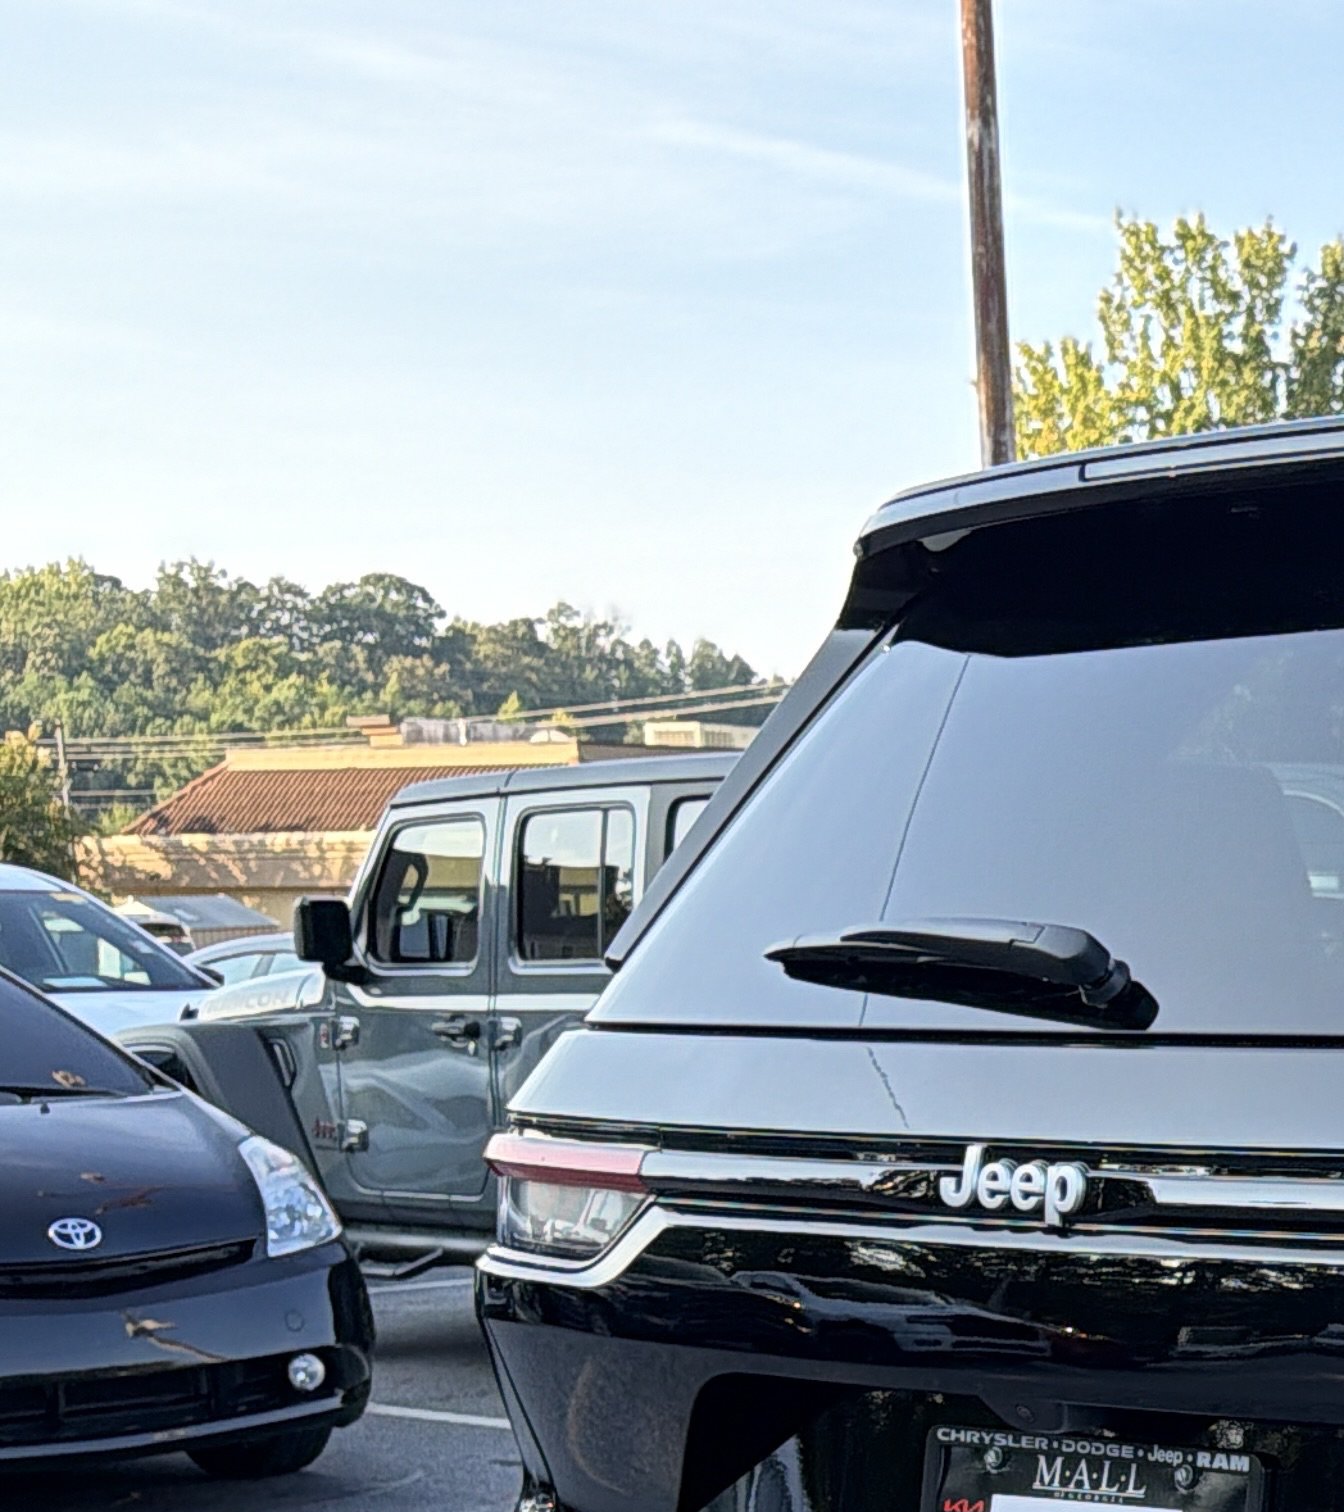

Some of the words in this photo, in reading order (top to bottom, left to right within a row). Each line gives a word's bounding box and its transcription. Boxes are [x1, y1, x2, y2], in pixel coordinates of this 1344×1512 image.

[940, 1143, 1088, 1226] Jeep
[936, 1427, 1049, 1450] CHRYSLER
[1061, 1438, 1134, 1459] DODGE
[1147, 1444, 1183, 1466] Jeep
[1196, 1450, 1249, 1473] RAM
